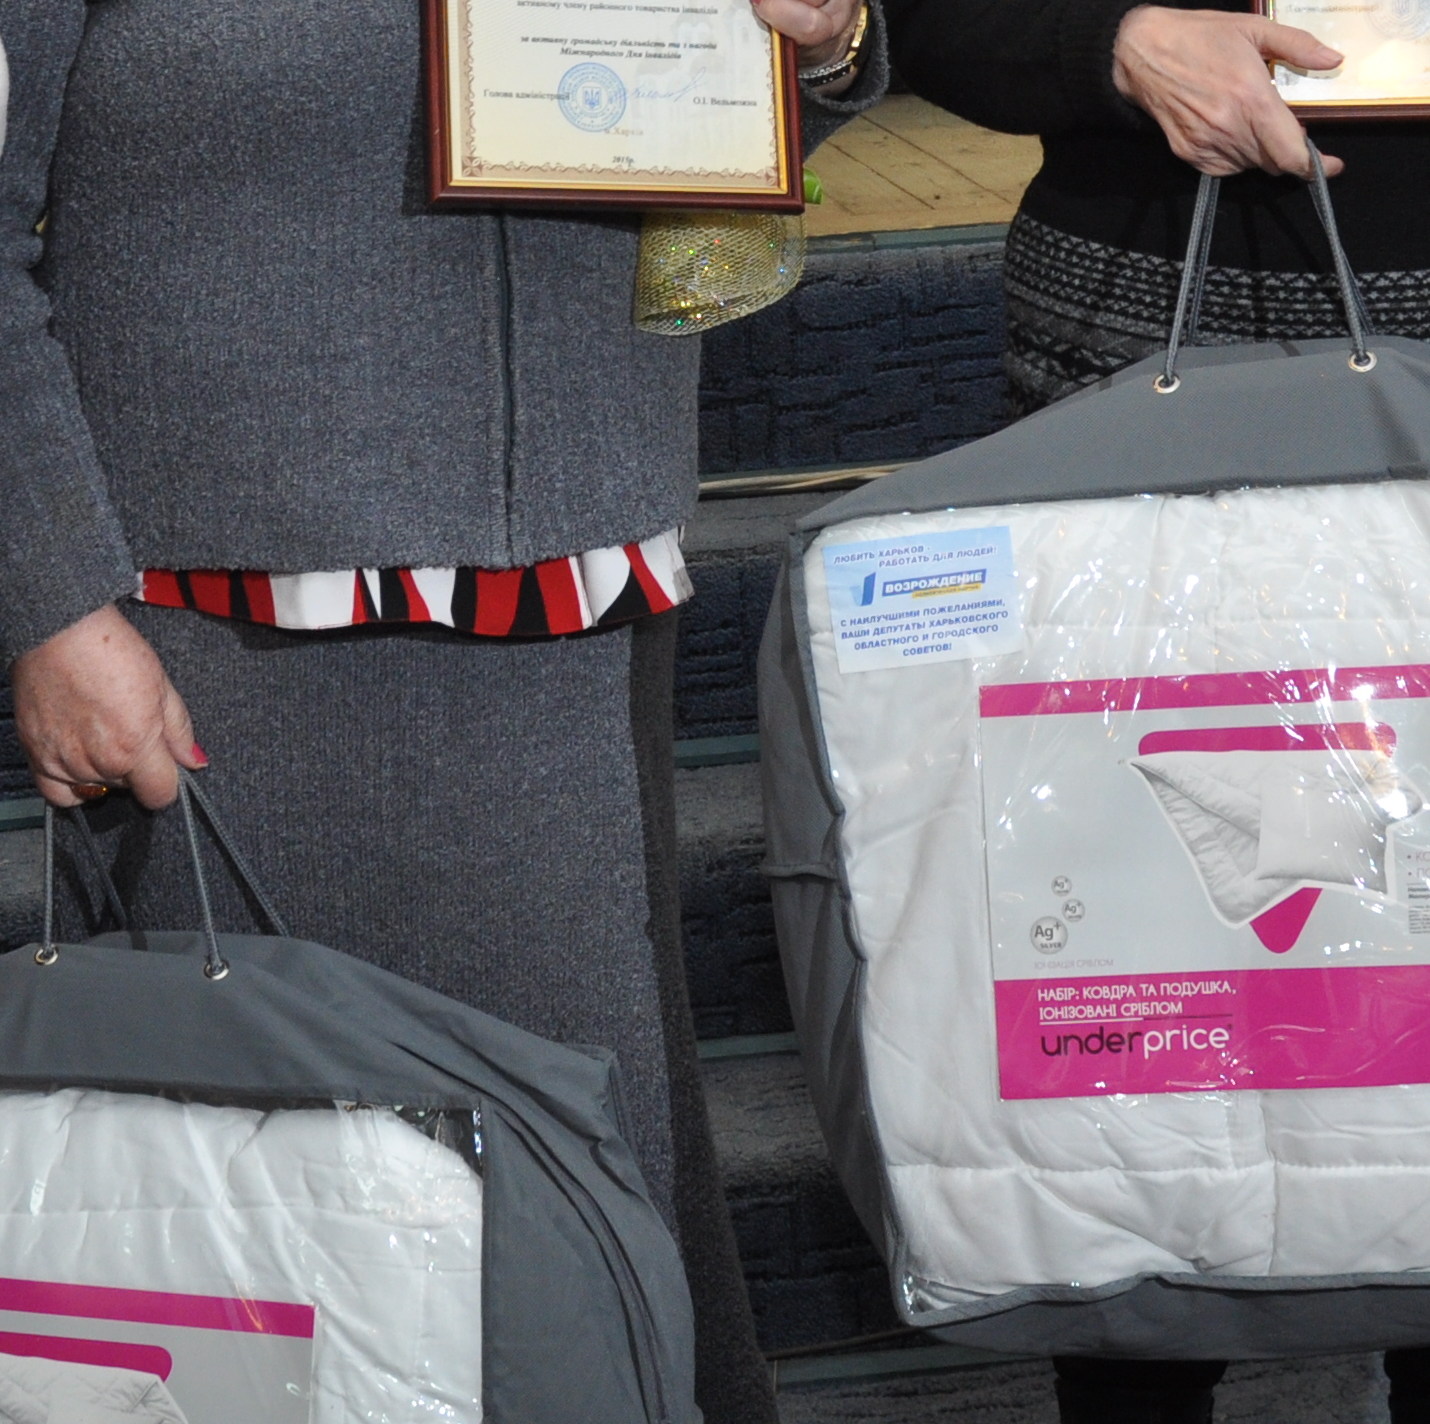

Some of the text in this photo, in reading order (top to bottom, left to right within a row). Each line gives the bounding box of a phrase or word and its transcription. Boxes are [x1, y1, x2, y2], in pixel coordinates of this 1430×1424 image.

[834, 551, 875, 565] ЛЮБИТЬ
[878, 545, 925, 558] ХАРЬКОВ
[879, 546, 997, 568] РАБОТАТЬ ДЛЯ ЛЮДЕЙ!
[885, 571, 983, 594] ВОЗРОЖДЕНИЕ
[840, 599, 1006, 627] С НАИЛУЧШИМИ ПОЖЕЛАНИЯМИ,
[841, 610, 1009, 640] ВАШИ ДЕПУТАТЫ ХАРЬКОВСКОГО
[854, 624, 999, 651] ОБЛАСТНОГО И ГОРОДСКОГО
[903, 643, 952, 657] СОВЕТОВ!
[1037, 980, 1237, 1002] НАБІР: КОВДРА ТА ПОДУШКА,
[1039, 1001, 1184, 1020] ІОНІЗОВАНІ СРІБЛОМ
[1041, 1024, 1231, 1060] underprice
